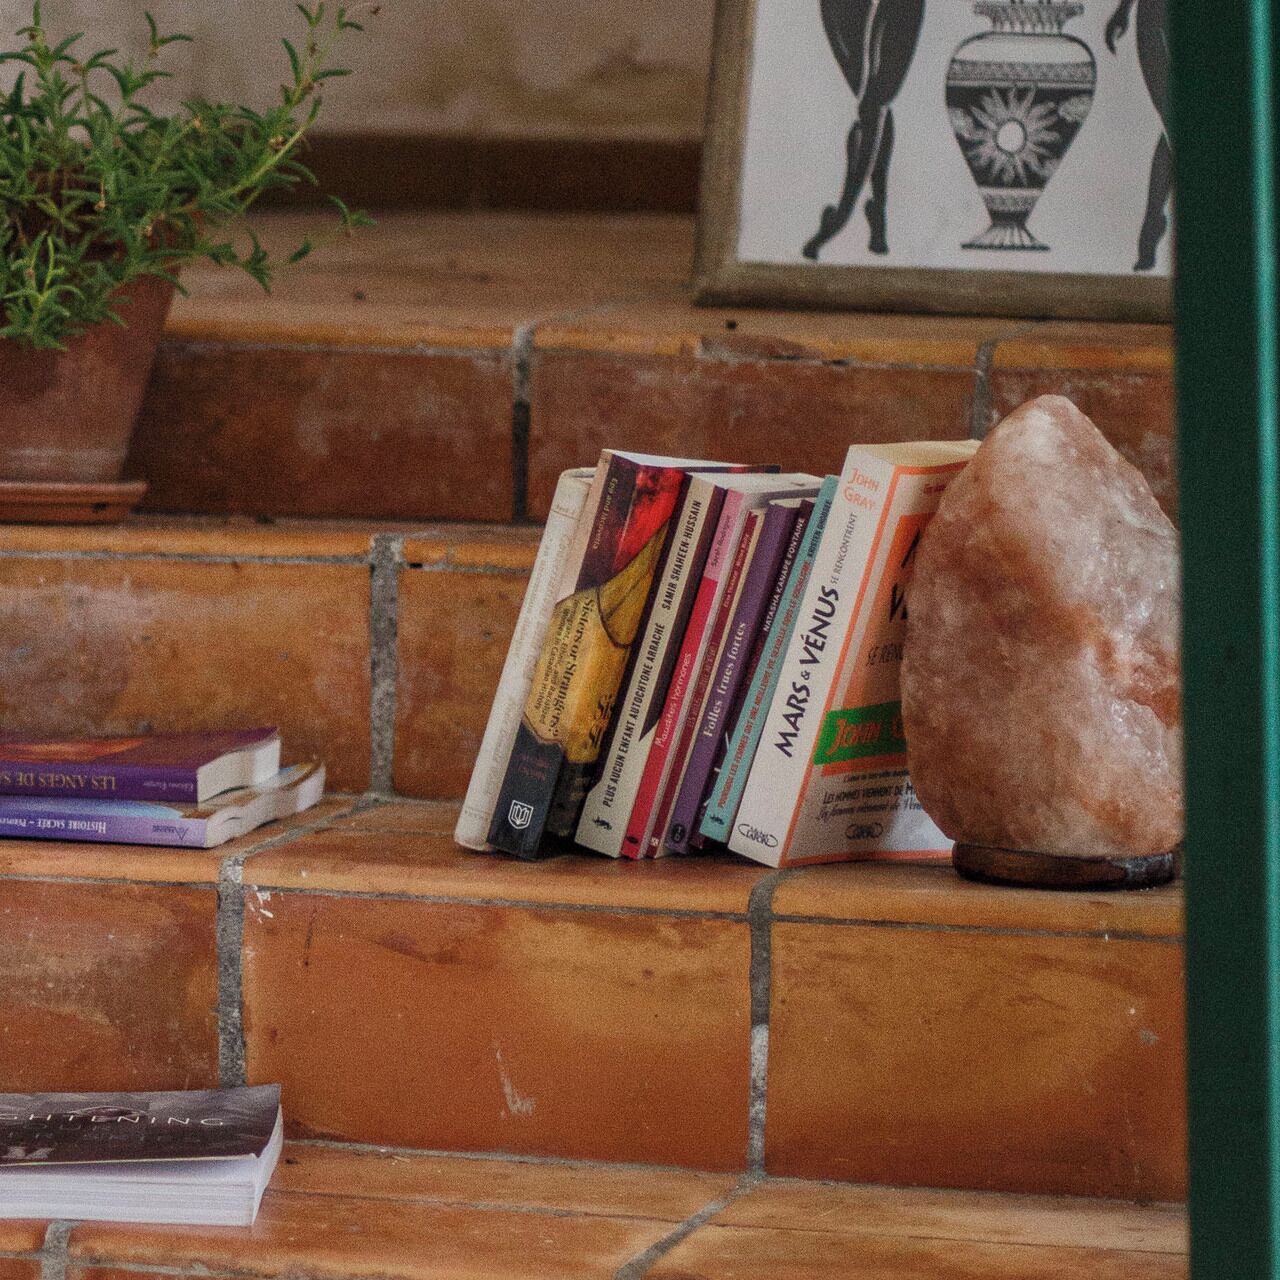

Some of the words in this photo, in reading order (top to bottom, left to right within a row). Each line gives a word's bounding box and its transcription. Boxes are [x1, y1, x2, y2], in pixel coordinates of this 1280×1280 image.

[847, 468, 880, 492] JOHN
[842, 486, 877, 510] GRAY
[668, 499, 702, 581] SHAHEEN-HUSSAIN
[831, 511, 858, 575] RENCONTRENT
[762, 594, 780, 632] NATASHA
[785, 516, 806, 558] FONTAINE
[660, 581, 677, 610] SAMIR
[571, 596, 595, 645] Sisters
[792, 582, 842, 669] VÉNUS
[542, 646, 558, 681] Canadian
[702, 699, 722, 737] Folles
[725, 620, 747, 660] fortes
[798, 668, 811, 681] &
[545, 660, 578, 737] Strangers?
[627, 662, 653, 719] AUTOCHTONE
[653, 700, 678, 748] Maudites
[669, 650, 692, 701] hormones
[617, 719, 636, 754] ENFANT
[770, 680, 813, 758] MARS
[16, 771, 34, 786] DE
[37, 772, 86, 789] ANGES
[90, 775, 116, 791] LES
[608, 753, 626, 784] AUCUN
[601, 783, 617, 808] PLUS
